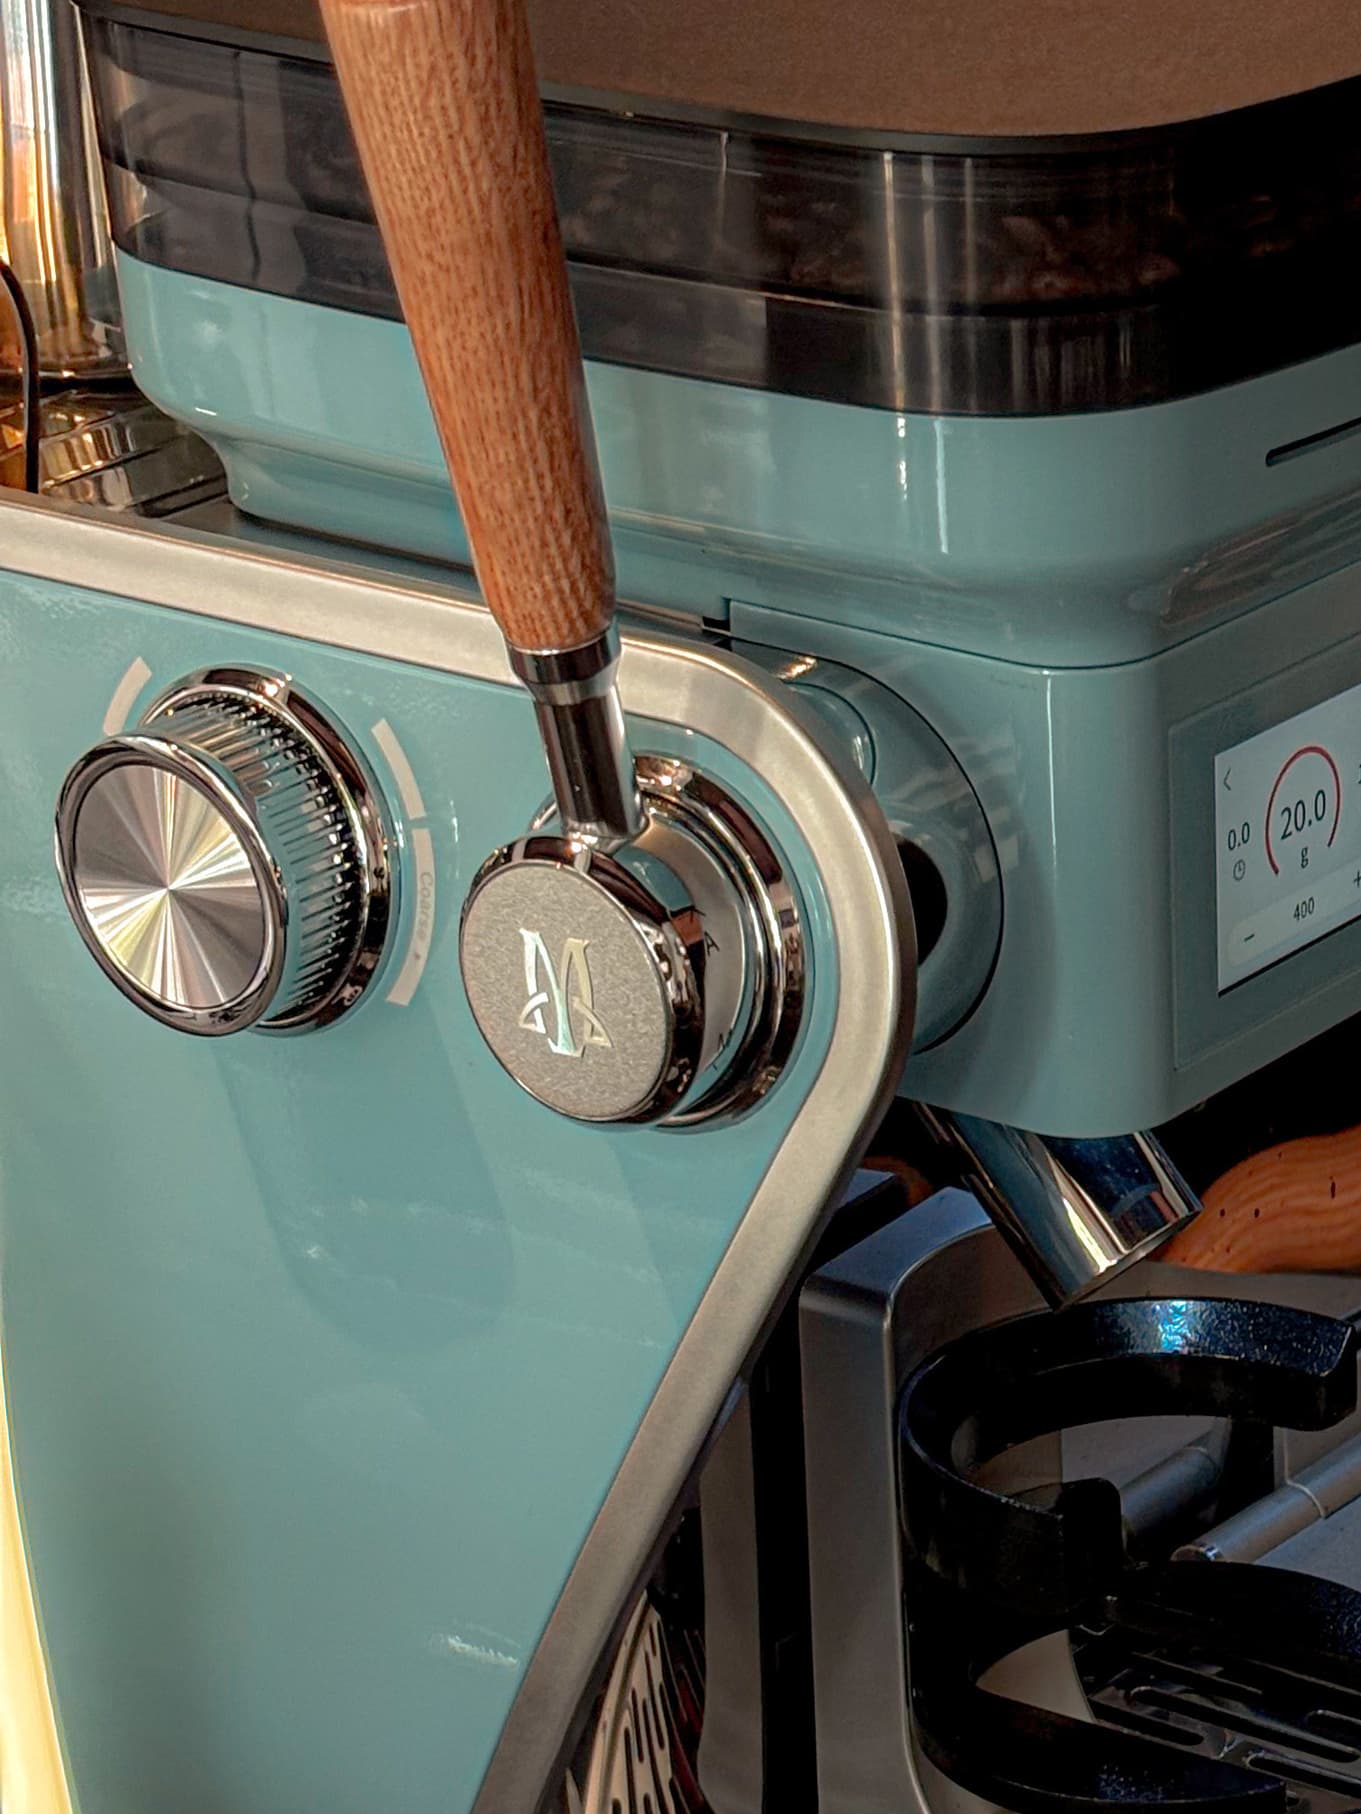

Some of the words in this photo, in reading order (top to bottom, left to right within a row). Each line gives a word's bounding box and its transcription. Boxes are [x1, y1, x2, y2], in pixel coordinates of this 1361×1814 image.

[1279, 788, 1328, 841] 20.0
[1227, 820, 1251, 852] 0.0
[1300, 845, 1309, 869] g
[1292, 896, 1316, 921] 400
